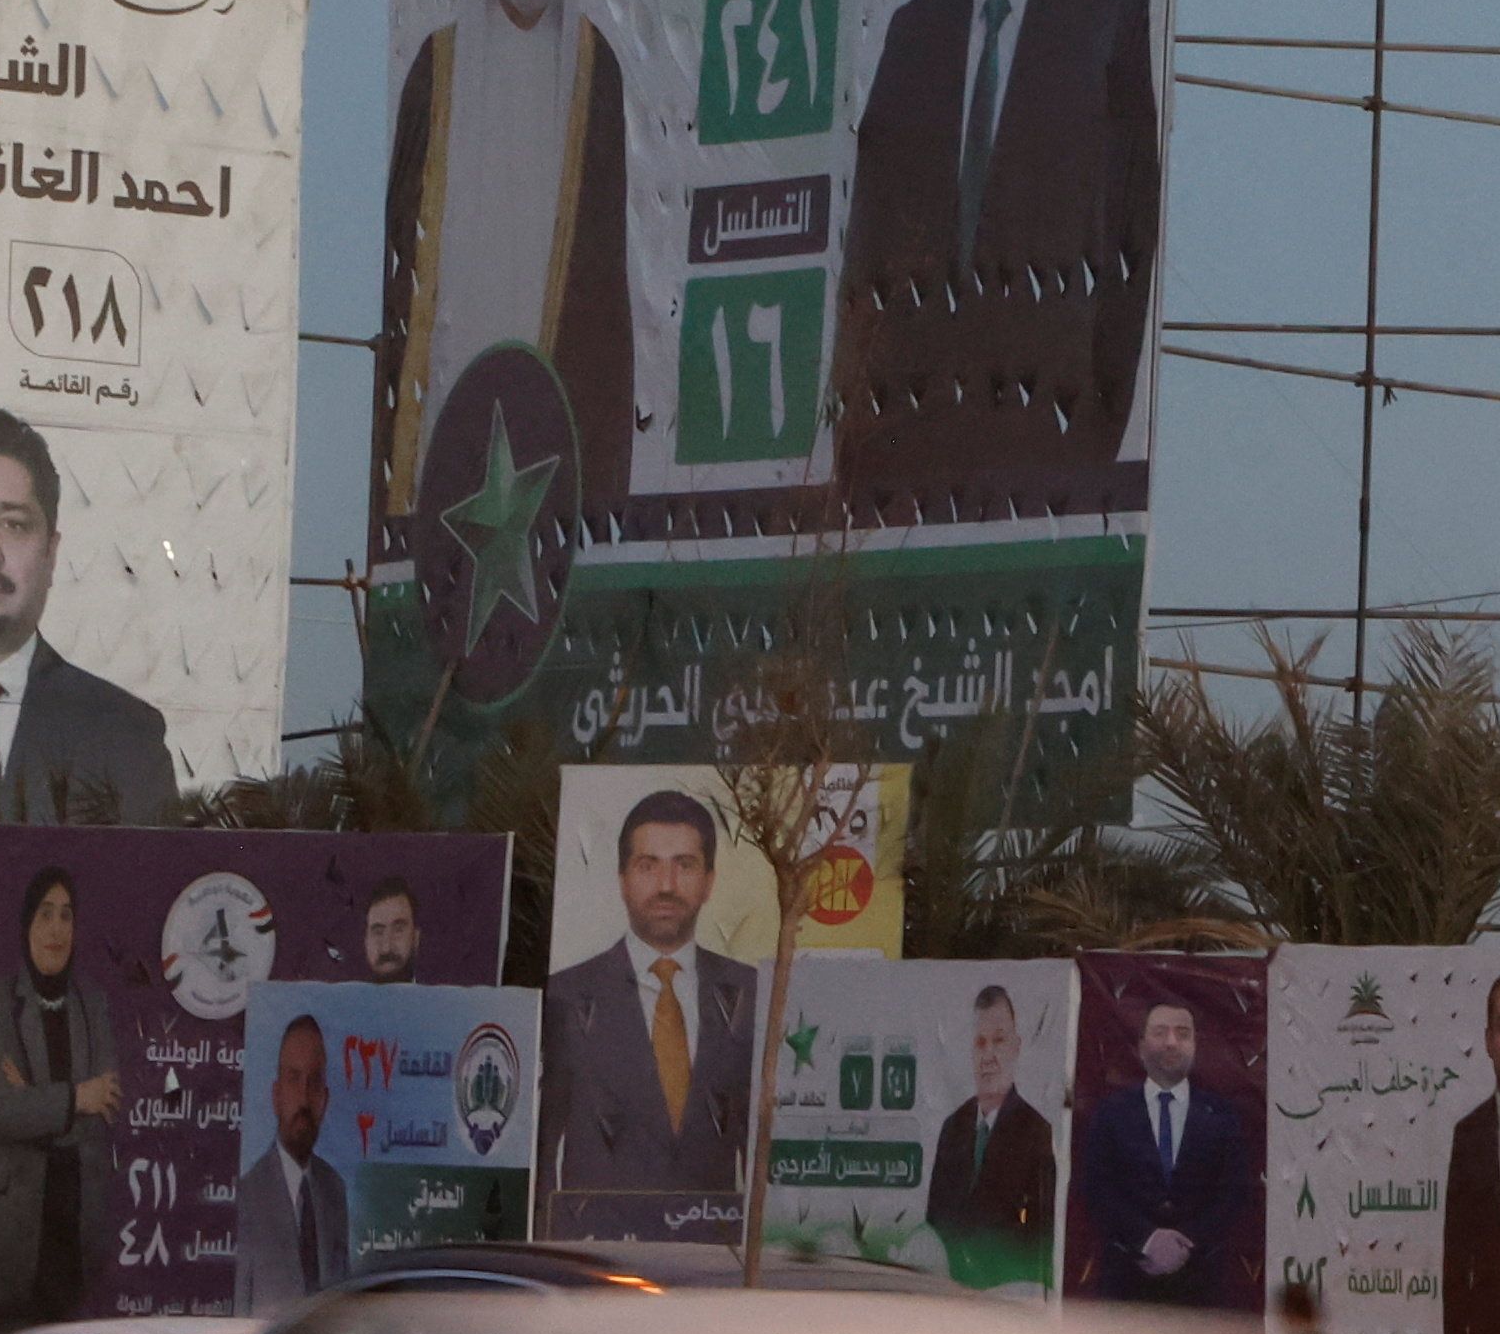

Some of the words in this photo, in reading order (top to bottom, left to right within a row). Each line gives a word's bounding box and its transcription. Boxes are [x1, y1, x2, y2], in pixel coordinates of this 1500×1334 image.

[112, 165, 232, 219] احمد
[703, 190, 813, 260] التسلسل
[22, 266, 128, 347] ٢١٨
[18, 373, 91, 397] القائمة
[95, 378, 140, 407] رقم
[710, 302, 788, 441] ١٦
[901, 637, 1013, 750] الشيخ
[146, 1037, 210, 1069] الوطنية
[1371, 1057, 1418, 1096] خلف
[196, 1092, 242, 1130] ونس
[128, 1157, 177, 1210] ٢١١
[1296, 1171, 1316, 1220] ٨
[1348, 1178, 1438, 1219] التسلسل
[663, 1198, 743, 1231] محامي
[117, 1218, 171, 1268] ٤٨
[1348, 1267, 1402, 1295] القائمة
